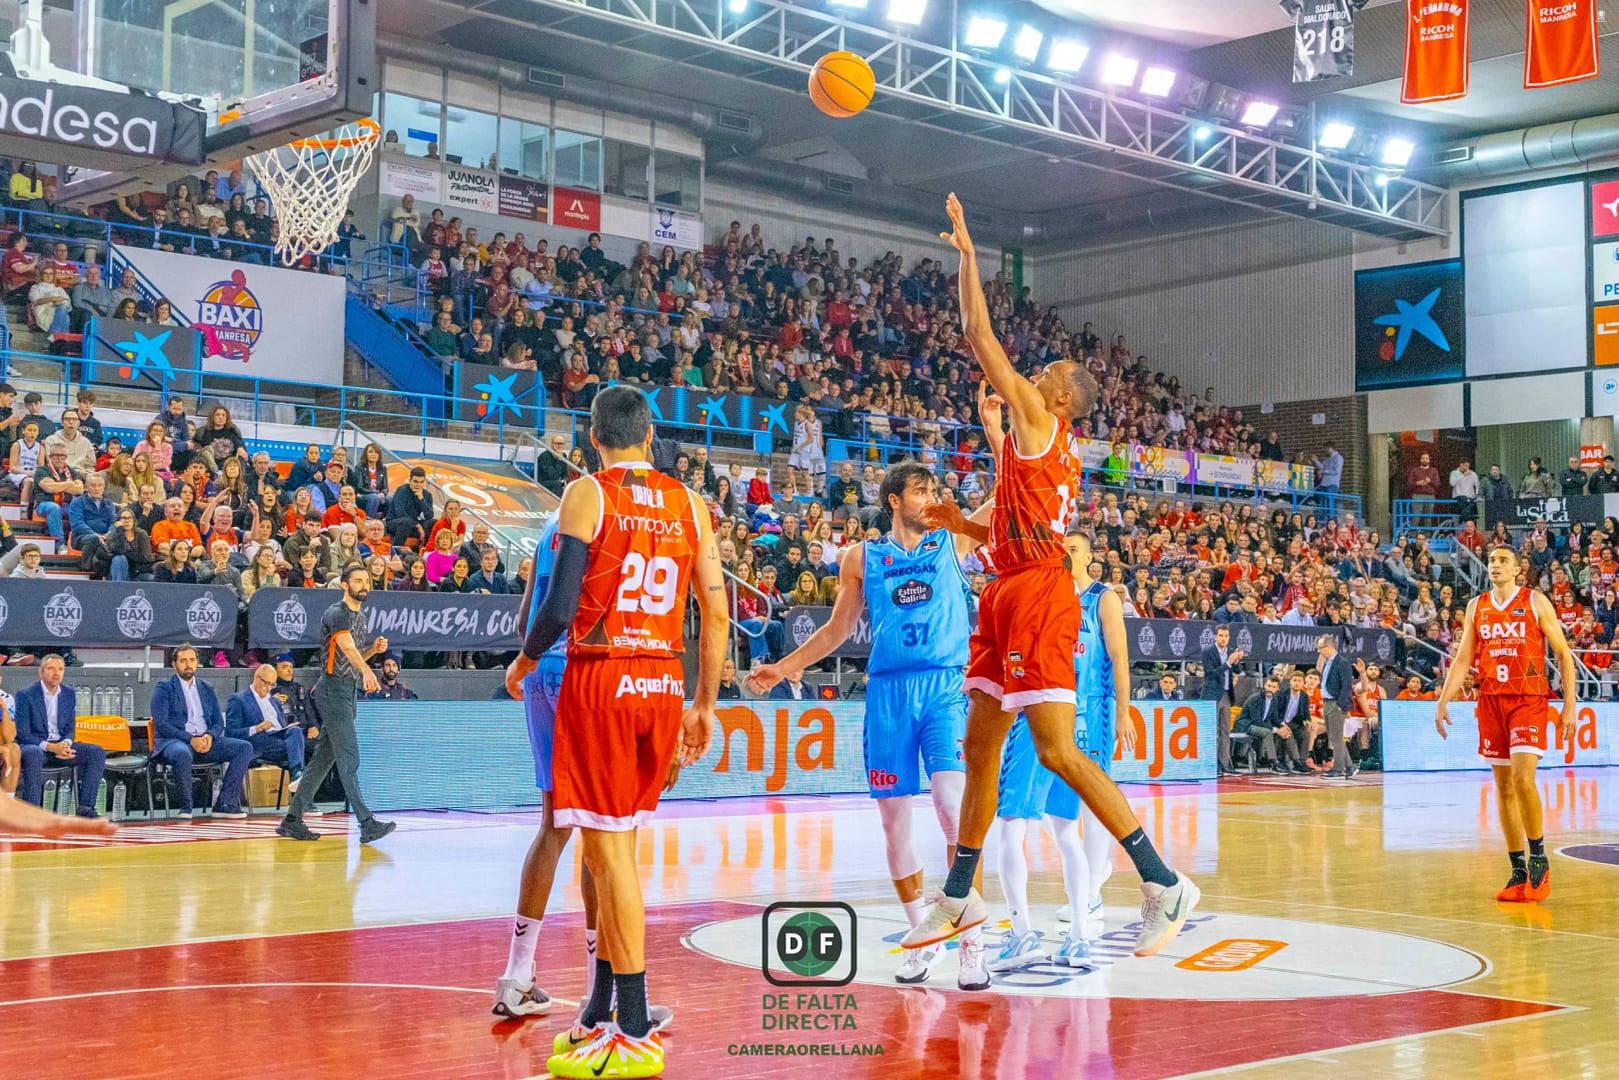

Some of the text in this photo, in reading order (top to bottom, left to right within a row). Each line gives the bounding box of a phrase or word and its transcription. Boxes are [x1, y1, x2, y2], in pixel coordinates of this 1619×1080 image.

[1540, 2, 1577, 17] RICOH
[1420, 24, 1455, 35] RICOH
[1302, 26, 1345, 56] 218
[448, 170, 495, 187] JUANOLA
[449, 194, 478, 205] expert
[654, 229, 677, 240] CEM
[201, 303, 261, 330] BAXI
[616, 552, 679, 616] 29
[897, 585, 927, 596] Estrella
[898, 593, 927, 604] Galicia
[46, 607, 81, 619] BAXI
[119, 608, 152, 621] BAXI
[189, 610, 220, 623] BAXI
[275, 612, 306, 624] BAXI
[902, 622, 930, 647] 37
[1480, 622, 1526, 639] BAXI
[1138, 635, 1155, 644] BAXI
[1169, 636, 1186, 645] BAXI
[1496, 664, 1509, 682] 8
